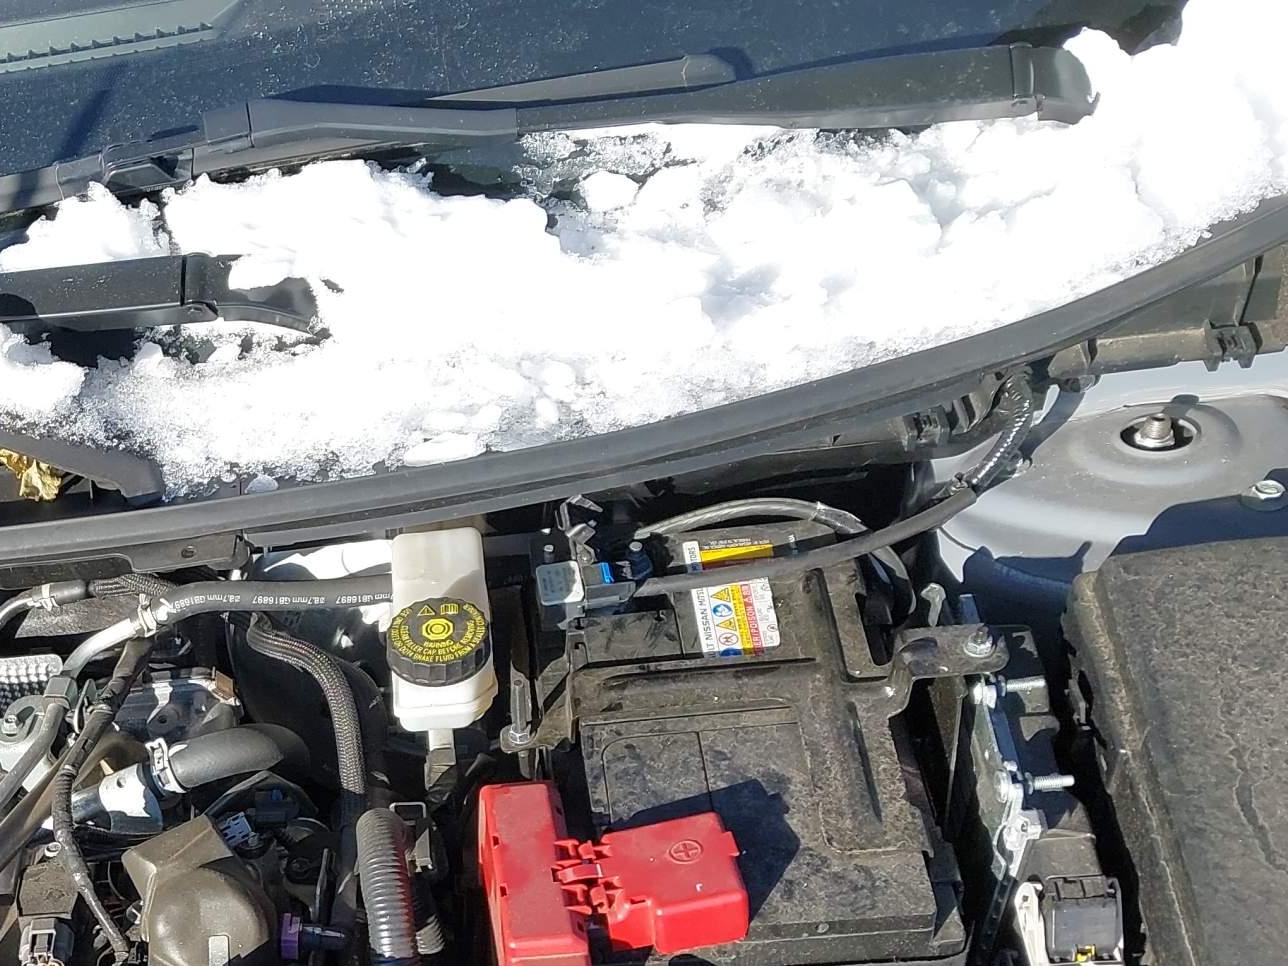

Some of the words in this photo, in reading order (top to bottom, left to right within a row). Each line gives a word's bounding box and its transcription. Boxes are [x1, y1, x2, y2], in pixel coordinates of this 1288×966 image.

[252, 595, 291, 605] GB16897
[700, 608, 713, 641] NISSAN
[423, 648, 437, 656] CAP
[435, 653, 455, 662] FLUID
